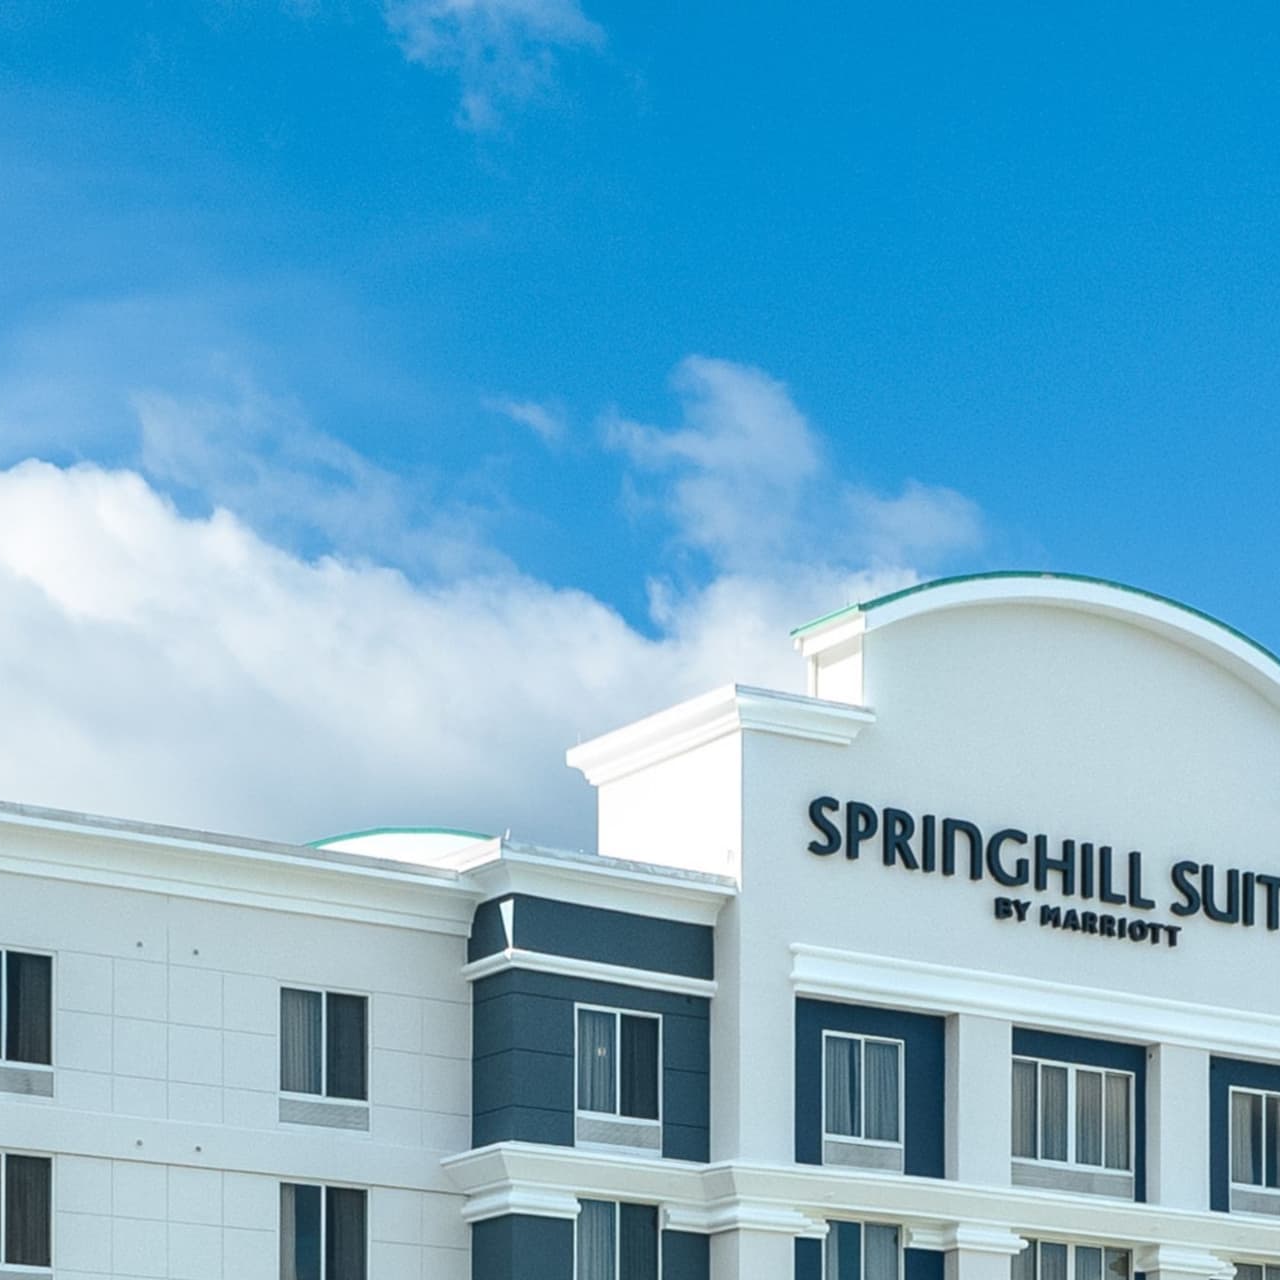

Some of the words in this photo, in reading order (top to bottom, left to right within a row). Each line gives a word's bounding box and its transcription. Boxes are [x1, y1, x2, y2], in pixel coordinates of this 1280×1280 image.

[808, 796, 1157, 909] SPRINGHILL
[993, 896, 1032, 921] BY
[1039, 904, 1183, 948] MARRIOTT
